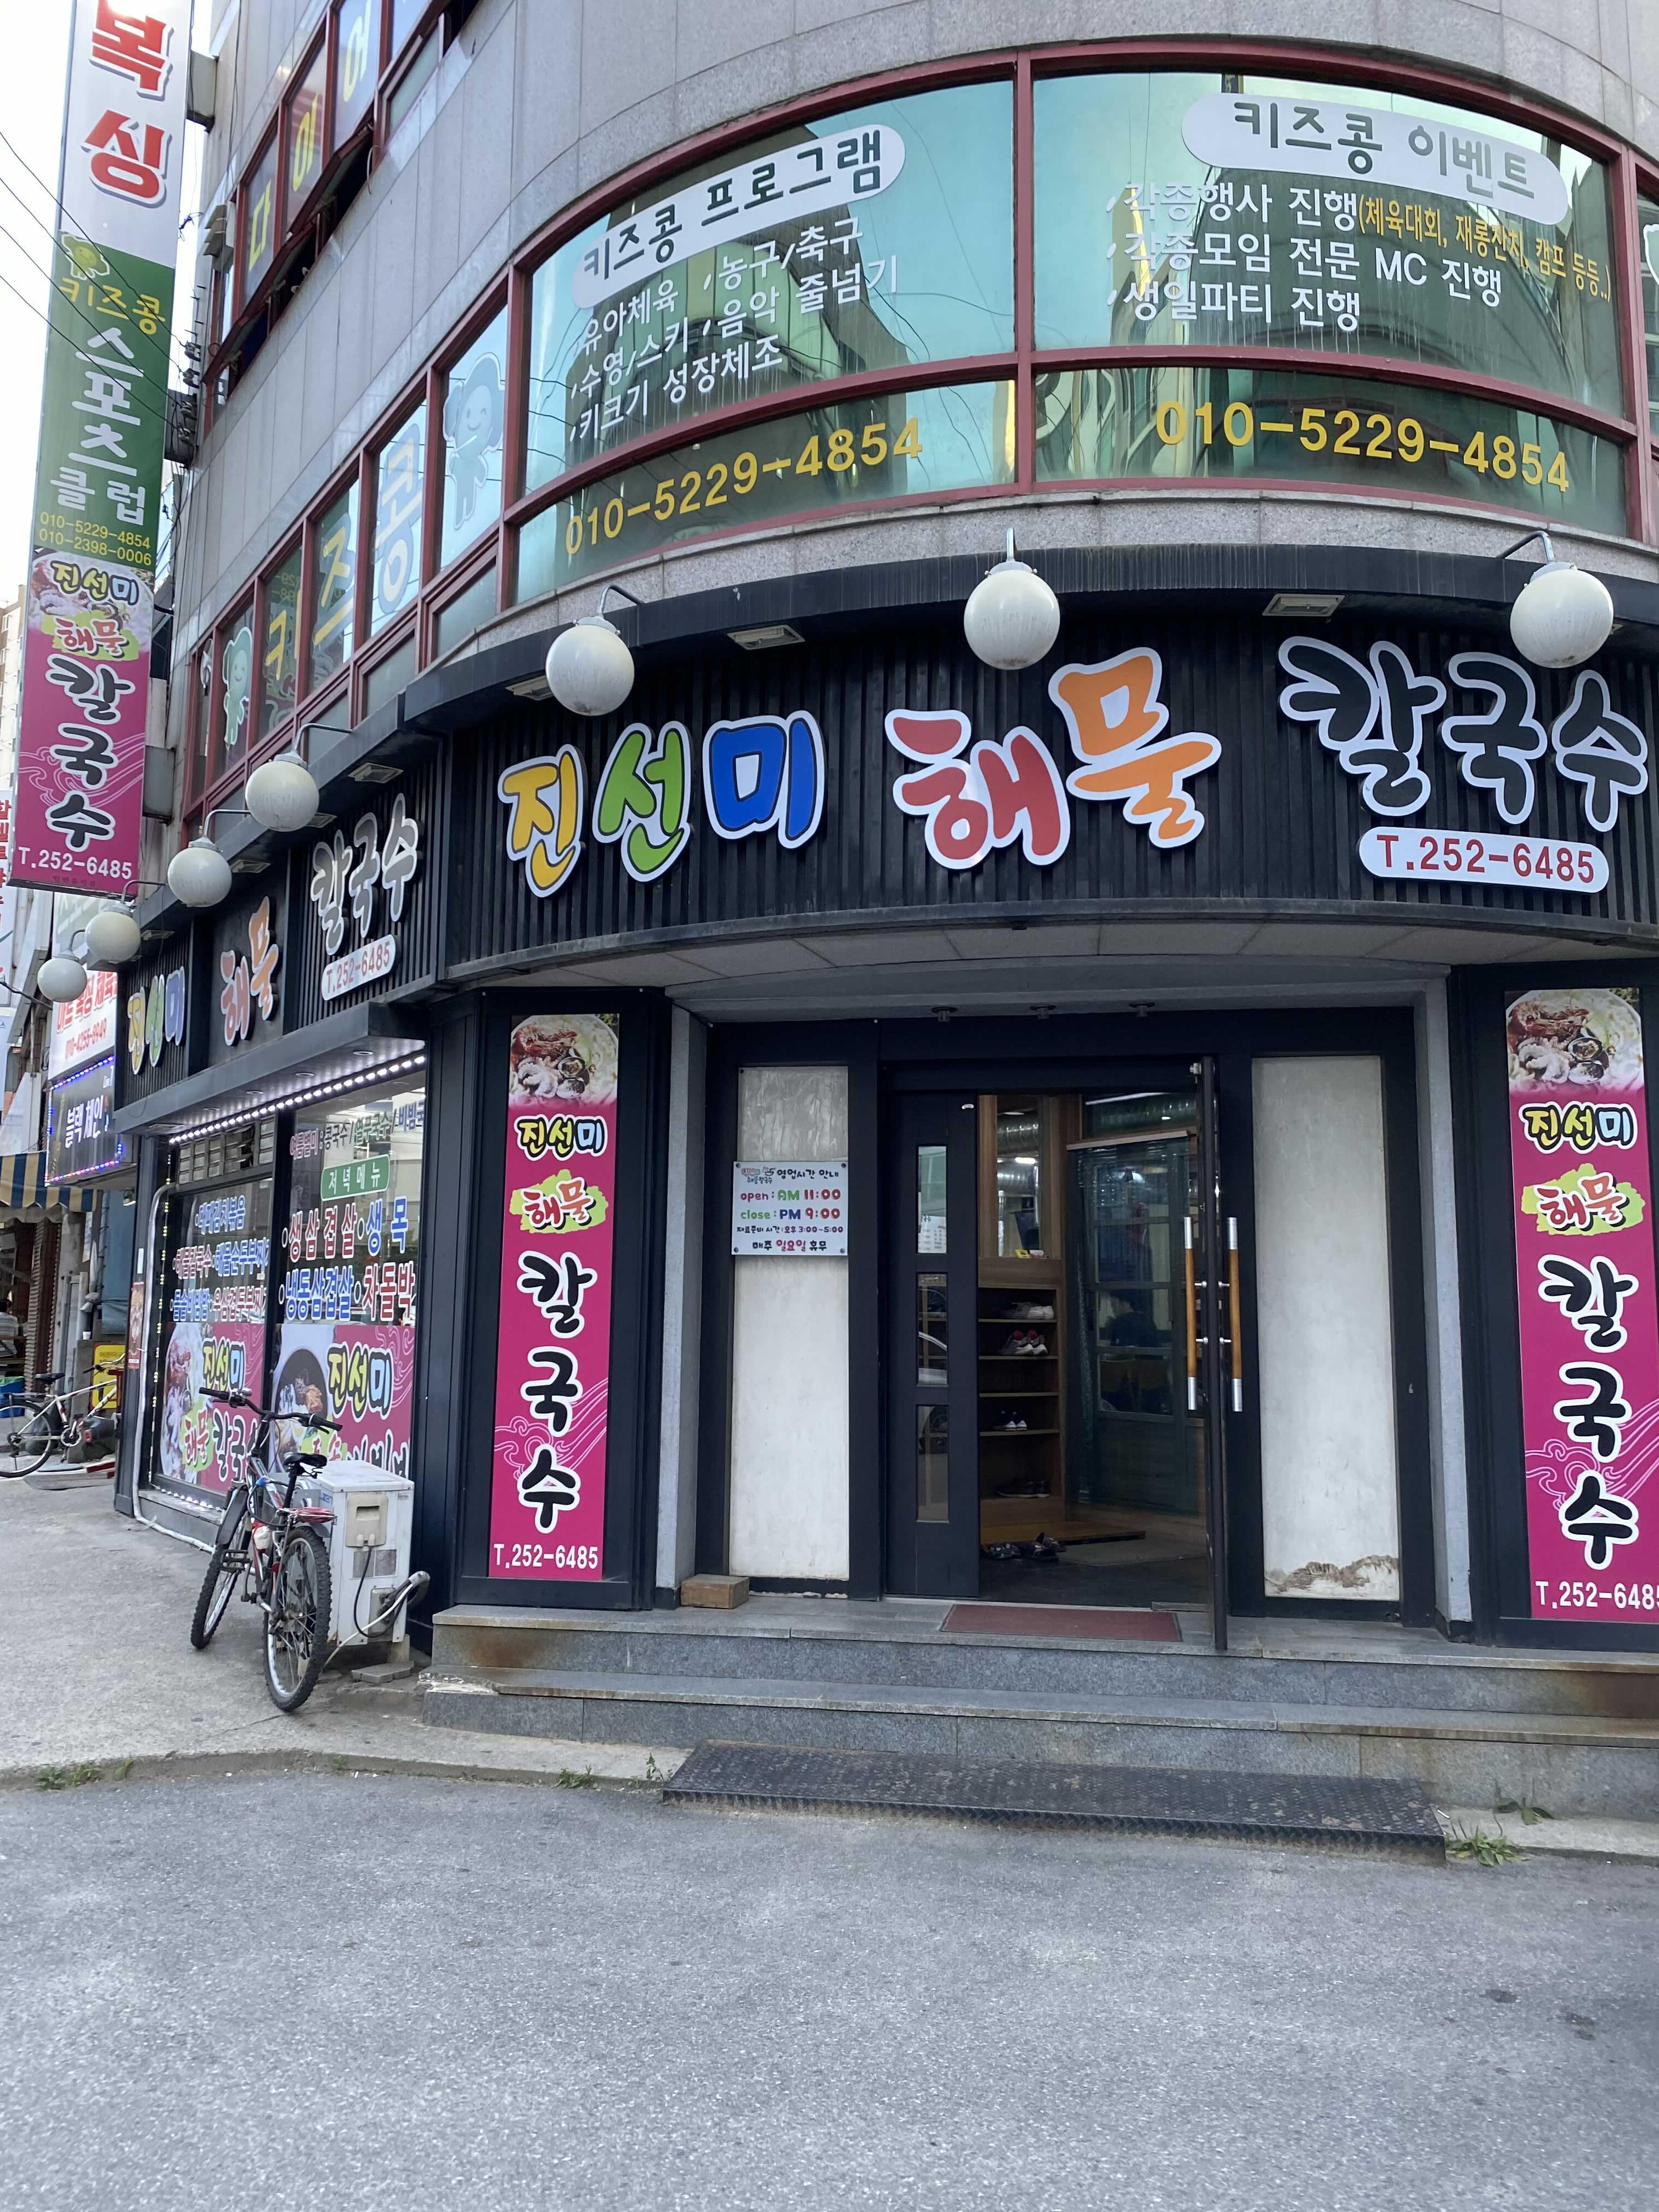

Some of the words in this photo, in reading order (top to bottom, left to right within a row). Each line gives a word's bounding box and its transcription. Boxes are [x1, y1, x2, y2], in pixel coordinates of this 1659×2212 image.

[1234, 101, 1383, 174] 키즈콩
[1409, 125, 1535, 200] 이벤트
[583, 203, 682, 281] 키즈콩
[701, 128, 881, 227] 프로그램
[1123, 182, 1273, 224] 각종행사
[1535, 237, 1567, 279] 캠프
[716, 286, 782, 338] 음악
[797, 255, 898, 315] 줄넘기
[1123, 229, 1272, 274] 각종모임
[1289, 236, 1361, 281] 전문
[1376, 247, 1427, 286] MC
[1442, 258, 1502, 308] 진행
[59, 276, 166, 335] 키즈콩
[583, 280, 680, 356] 유아체육
[1123, 280, 1273, 324] 생일파티
[1290, 287, 1361, 331] 진행
[578, 380, 650, 442] 키크기
[662, 334, 783, 404] 성장체조
[1156, 400, 1570, 493] 010-5229-4854
[565, 417, 924, 555] 010-5229-4854
[38, 528, 152, 566] 010-2398-0006
[40, 511, 151, 549] 010-5229-4854
[50, 560, 140, 606] 진선미
[54, 616, 129, 657] 해물
[46, 654, 136, 852] 칼국수
[498, 710, 825, 898] 진선미
[884, 646, 1222, 870] 해물
[1278, 636, 1649, 832] 칼국수
[18, 847, 132, 879] T.252-6485
[1376, 833, 1594, 883] T.252-6485
[127, 966, 186, 1075] 진선미
[221, 895, 279, 1046] 해물
[311, 792, 419, 956] 칼국수
[326, 940, 391, 995] T.252-6485
[515, 1114, 608, 1161] 진선미
[1518, 1101, 1638, 1155] 진선미
[777, 1169, 815, 1179] 영업시간
[819, 1170, 839, 1179] 안내
[777, 1189, 799, 1200] AM
[804, 1189, 840, 1200] 11:00
[1534, 1172, 1629, 1232] 해물
[522, 1176, 595, 1230] 해물
[780, 1209, 801, 1220] PM
[805, 1207, 840, 1220] 9:00
[752, 1240, 772, 1251] 매주
[776, 1239, 806, 1251] 일요일
[809, 1240, 827, 1251] 휴무
[286, 1265, 354, 1321] 냉동삼겹살
[362, 1260, 416, 1322] 차돌박
[202, 1336, 246, 1390] 진선미
[327, 1341, 394, 1422] 진선미
[517, 1250, 597, 1534] 칼국수
[1538, 1254, 1640, 1571] 칼국수
[184, 1409, 210, 1466] 해물
[494, 1543, 599, 1570] T.252-6485
[1536, 1580, 1659, 1611] T.252-648
